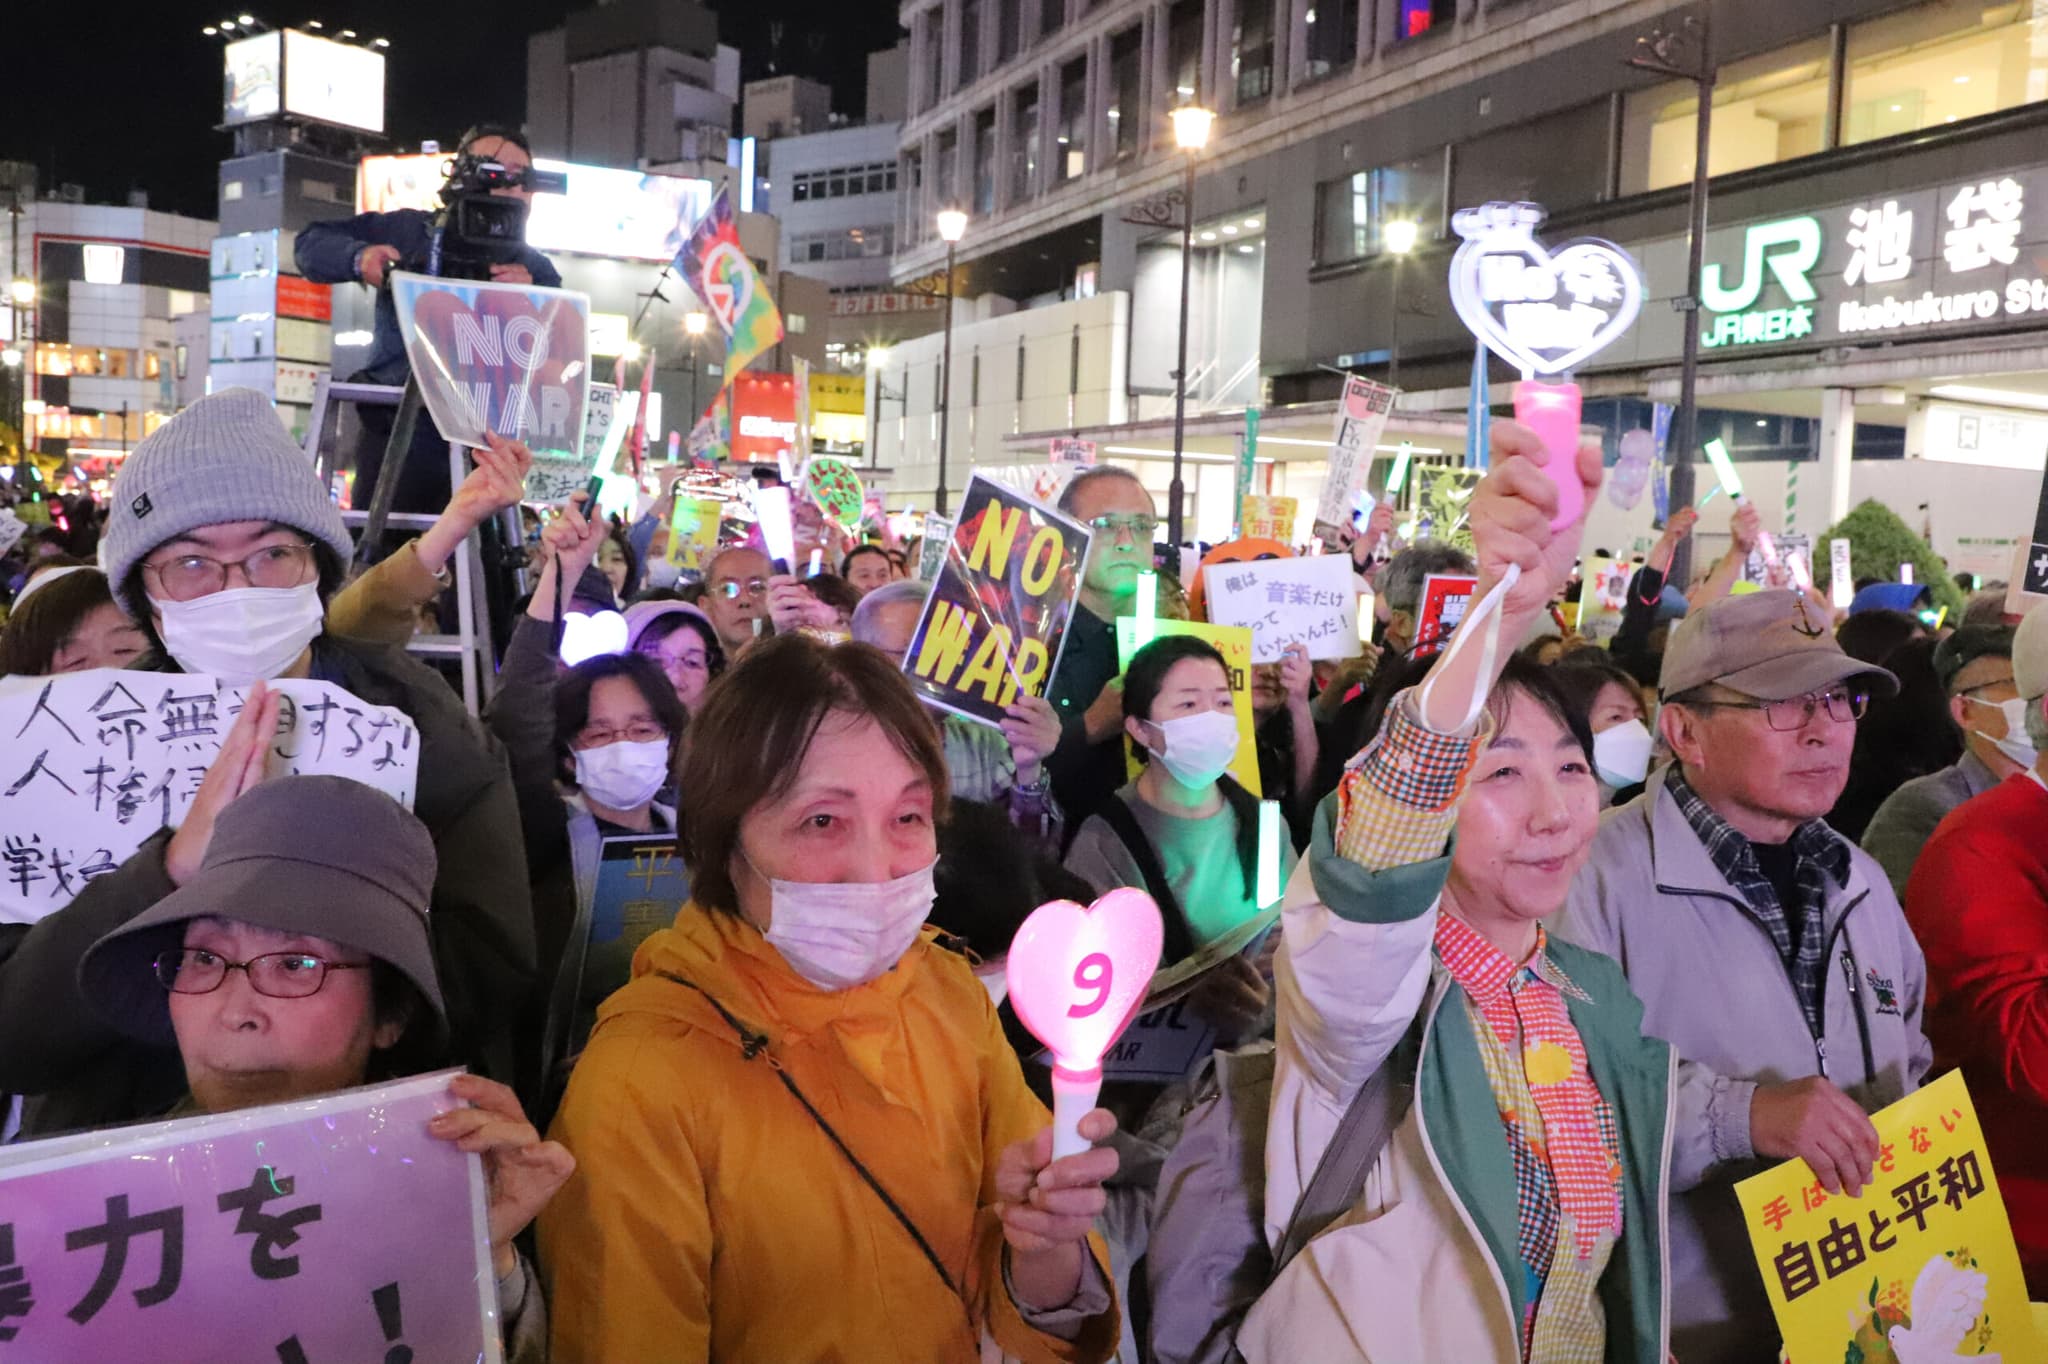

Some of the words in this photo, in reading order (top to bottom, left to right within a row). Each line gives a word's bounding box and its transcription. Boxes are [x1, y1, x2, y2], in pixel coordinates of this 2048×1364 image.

[1701, 216, 1822, 313] JR
[1842, 177, 2025, 287] 池袋
[452, 312, 550, 371] NO
[1701, 304, 1814, 349] JR東日本
[1838, 289, 2000, 334] Ikebukuro
[436, 379, 571, 438] WAR
[968, 498, 1064, 597] NO
[1265, 580, 1344, 608] 音楽だけ
[914, 600, 1049, 707] WAR
[1067, 952, 1113, 1019] 9
[1773, 1149, 1986, 1303] 自由と平和
